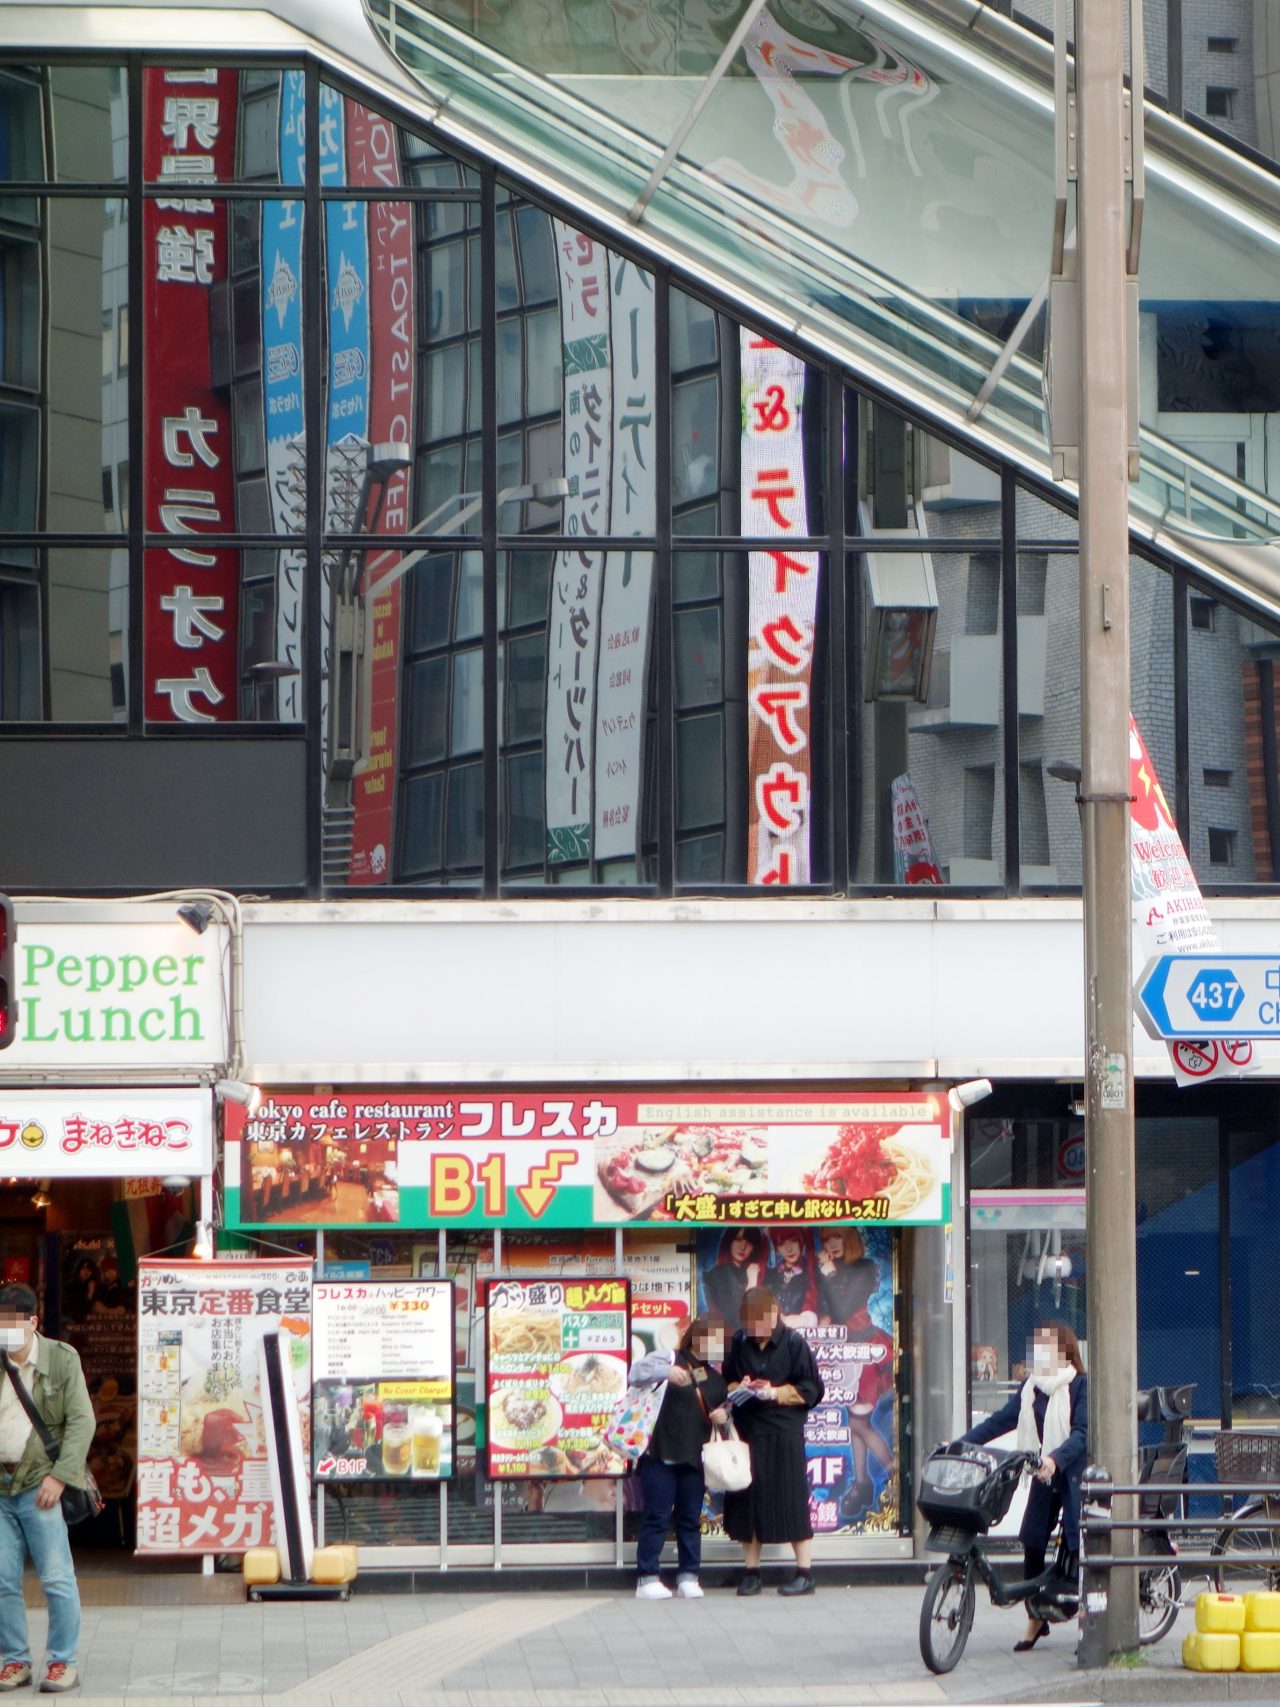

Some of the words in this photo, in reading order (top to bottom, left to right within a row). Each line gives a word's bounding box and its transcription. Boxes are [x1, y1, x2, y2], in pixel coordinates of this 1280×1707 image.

[22, 944, 205, 992] Pepper
[1192, 981, 1240, 1009] 437
[22, 994, 205, 1041] Lunch
[247, 1101, 303, 1122] Tokyo
[309, 1100, 348, 1119] cafe
[354, 1101, 454, 1119] restaurant
[459, 1099, 618, 1138] フレスカ
[646, 1106, 712, 1120] English
[719, 1106, 813, 1118] assistance
[820, 1105, 837, 1118] is
[842, 1105, 926, 1118] available
[61, 1115, 191, 1154] まねきねこ
[246, 1121, 456, 1142] 東京カフェレストラン
[432, 1153, 505, 1216] B1
[141, 1288, 311, 1316] 東京定番食堂
[389, 1300, 430, 1312] ¥330
[384, 1386, 393, 1394] No
[395, 1386, 417, 1394] Cover
[336, 1459, 367, 1474] B1F
